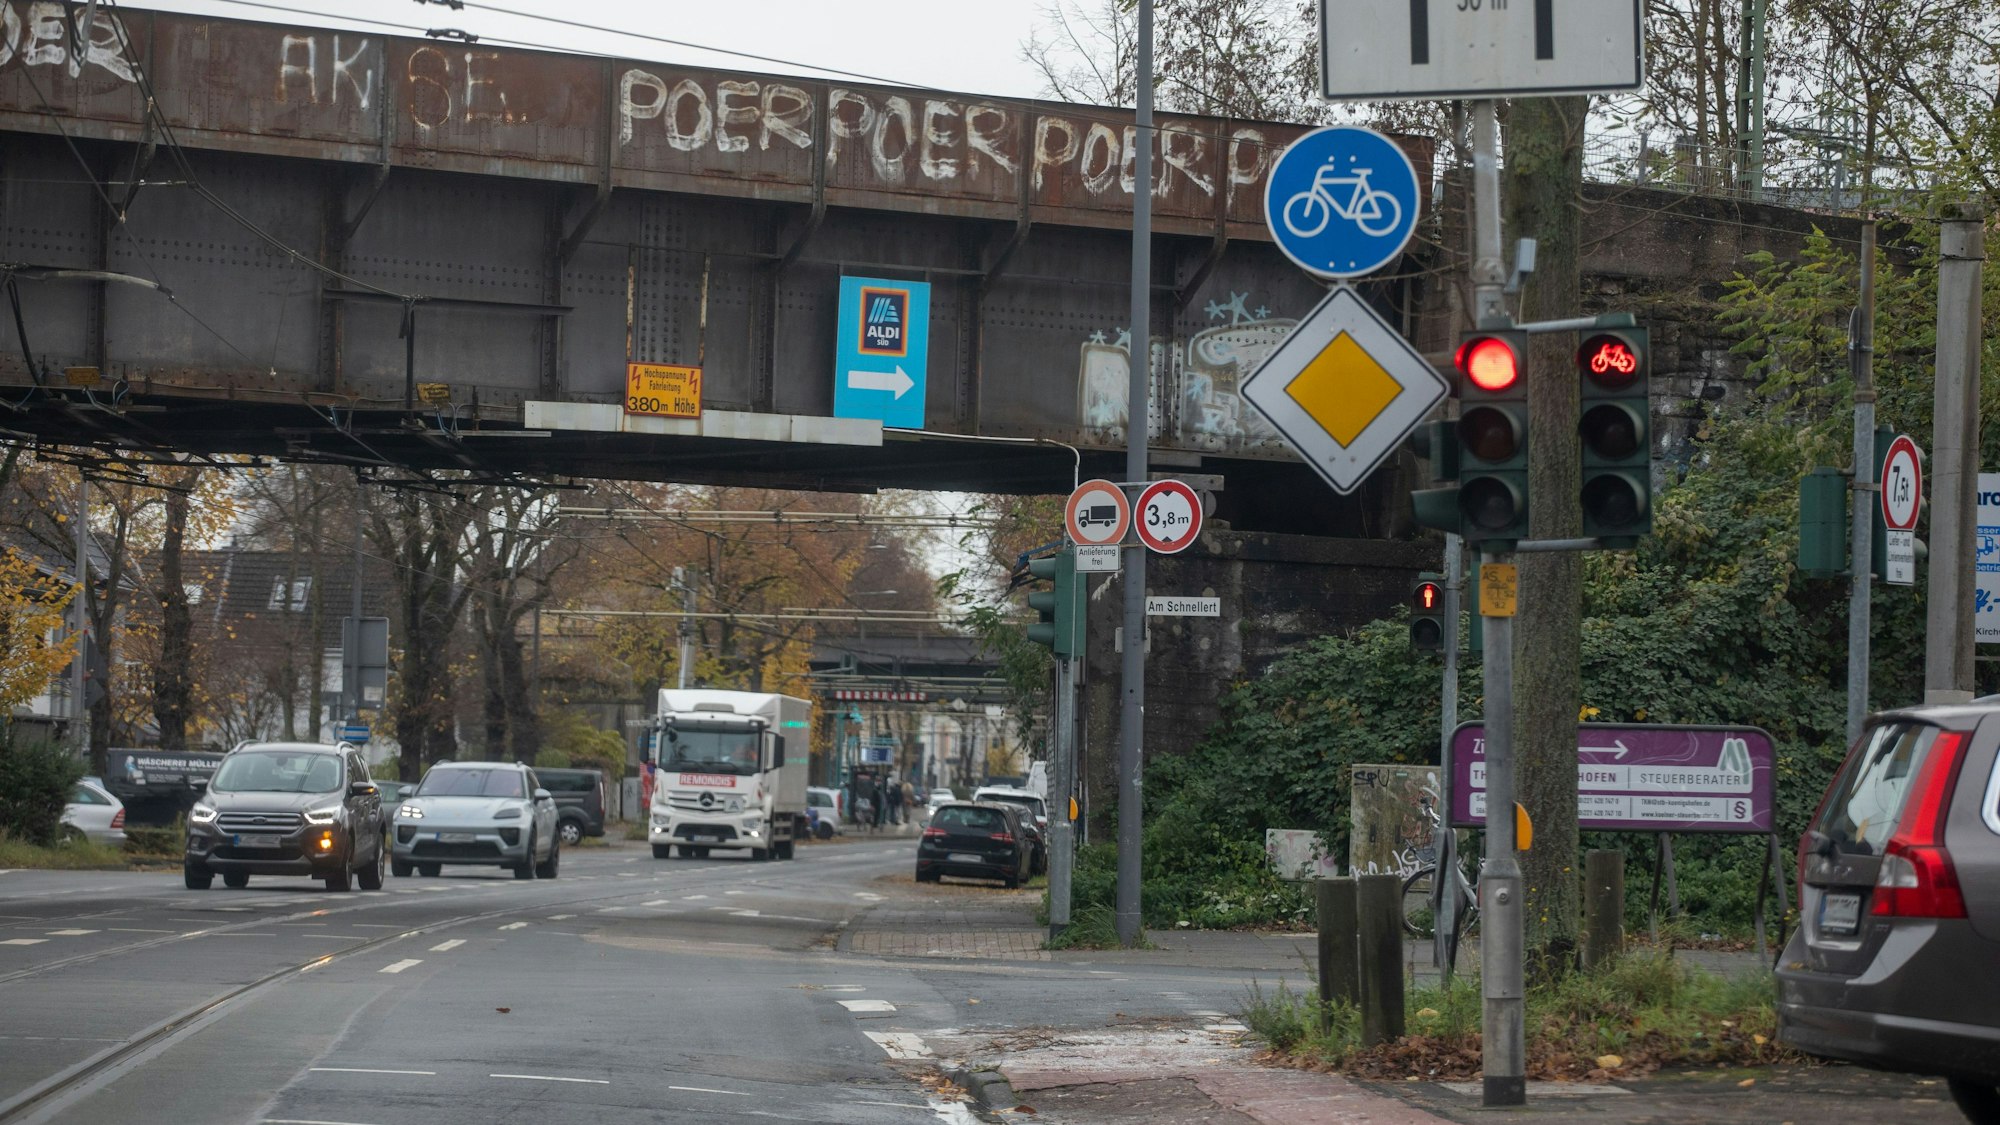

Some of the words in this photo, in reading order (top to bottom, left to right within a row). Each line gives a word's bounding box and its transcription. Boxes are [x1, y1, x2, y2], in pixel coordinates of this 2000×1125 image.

[619, 68, 813, 152] POER
[826, 89, 1019, 181] POER
[867, 325, 900, 339] ALDI
[876, 338, 890, 346] SÜD
[644, 368, 687, 383] Hochspannung
[649, 380, 681, 394] Fahrleitung
[674, 397, 696, 414] Höhe
[1893, 465, 1909, 508] 7,5t
[1078, 548, 1116, 557] Anlieferung
[1091, 557, 1103, 566] frei
[1148, 601, 1164, 612] Am
[1167, 600, 1217, 613] Schnellert
[137, 757, 187, 766] WÄSCHEREI
[680, 774, 731, 785] REMONDIS
[1640, 772, 1741, 786] STEUERBERATER
